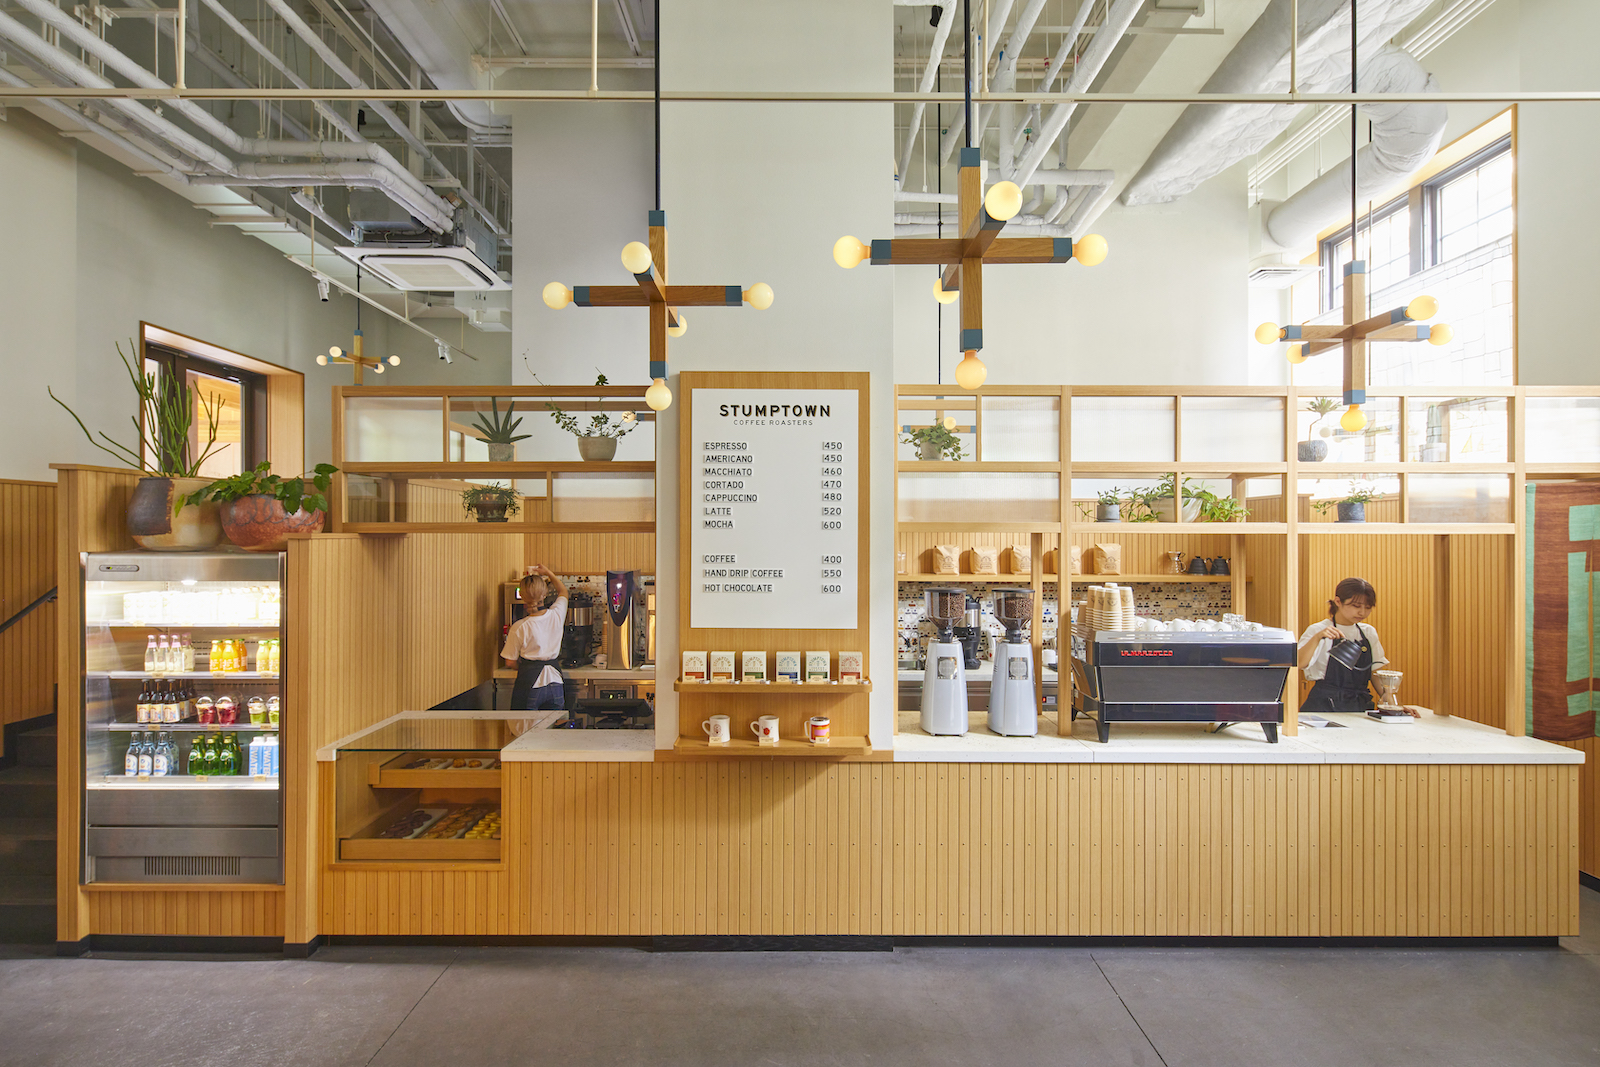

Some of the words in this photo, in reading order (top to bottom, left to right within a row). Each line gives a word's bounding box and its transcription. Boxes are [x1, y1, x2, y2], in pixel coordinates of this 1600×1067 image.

[719, 405, 831, 418] STUMPTOWN
[705, 442, 747, 450] ESPRESSO
[824, 442, 843, 450] 450
[705, 454, 753, 463] AMERICANO
[824, 454, 843, 463] 450
[704, 467, 752, 476] MACCHIATO
[824, 467, 842, 475] 460
[705, 480, 744, 489] CORTADO
[824, 480, 842, 488] 470
[705, 493, 758, 502] CAPPUCCINO
[824, 493, 842, 501] 480
[705, 507, 732, 515] LATTE
[824, 507, 842, 516] 520
[704, 520, 734, 528] MOCHA
[823, 521, 842, 530] 600
[704, 555, 736, 563] COFFEE
[824, 555, 842, 564] 400
[704, 569, 727, 577] HAND
[729, 569, 748, 577] DRIP
[752, 569, 783, 578] COFFEE
[824, 569, 842, 578] 550
[704, 584, 721, 592] HOT
[724, 584, 773, 592] CHOCOLATE
[823, 584, 842, 593] 600
